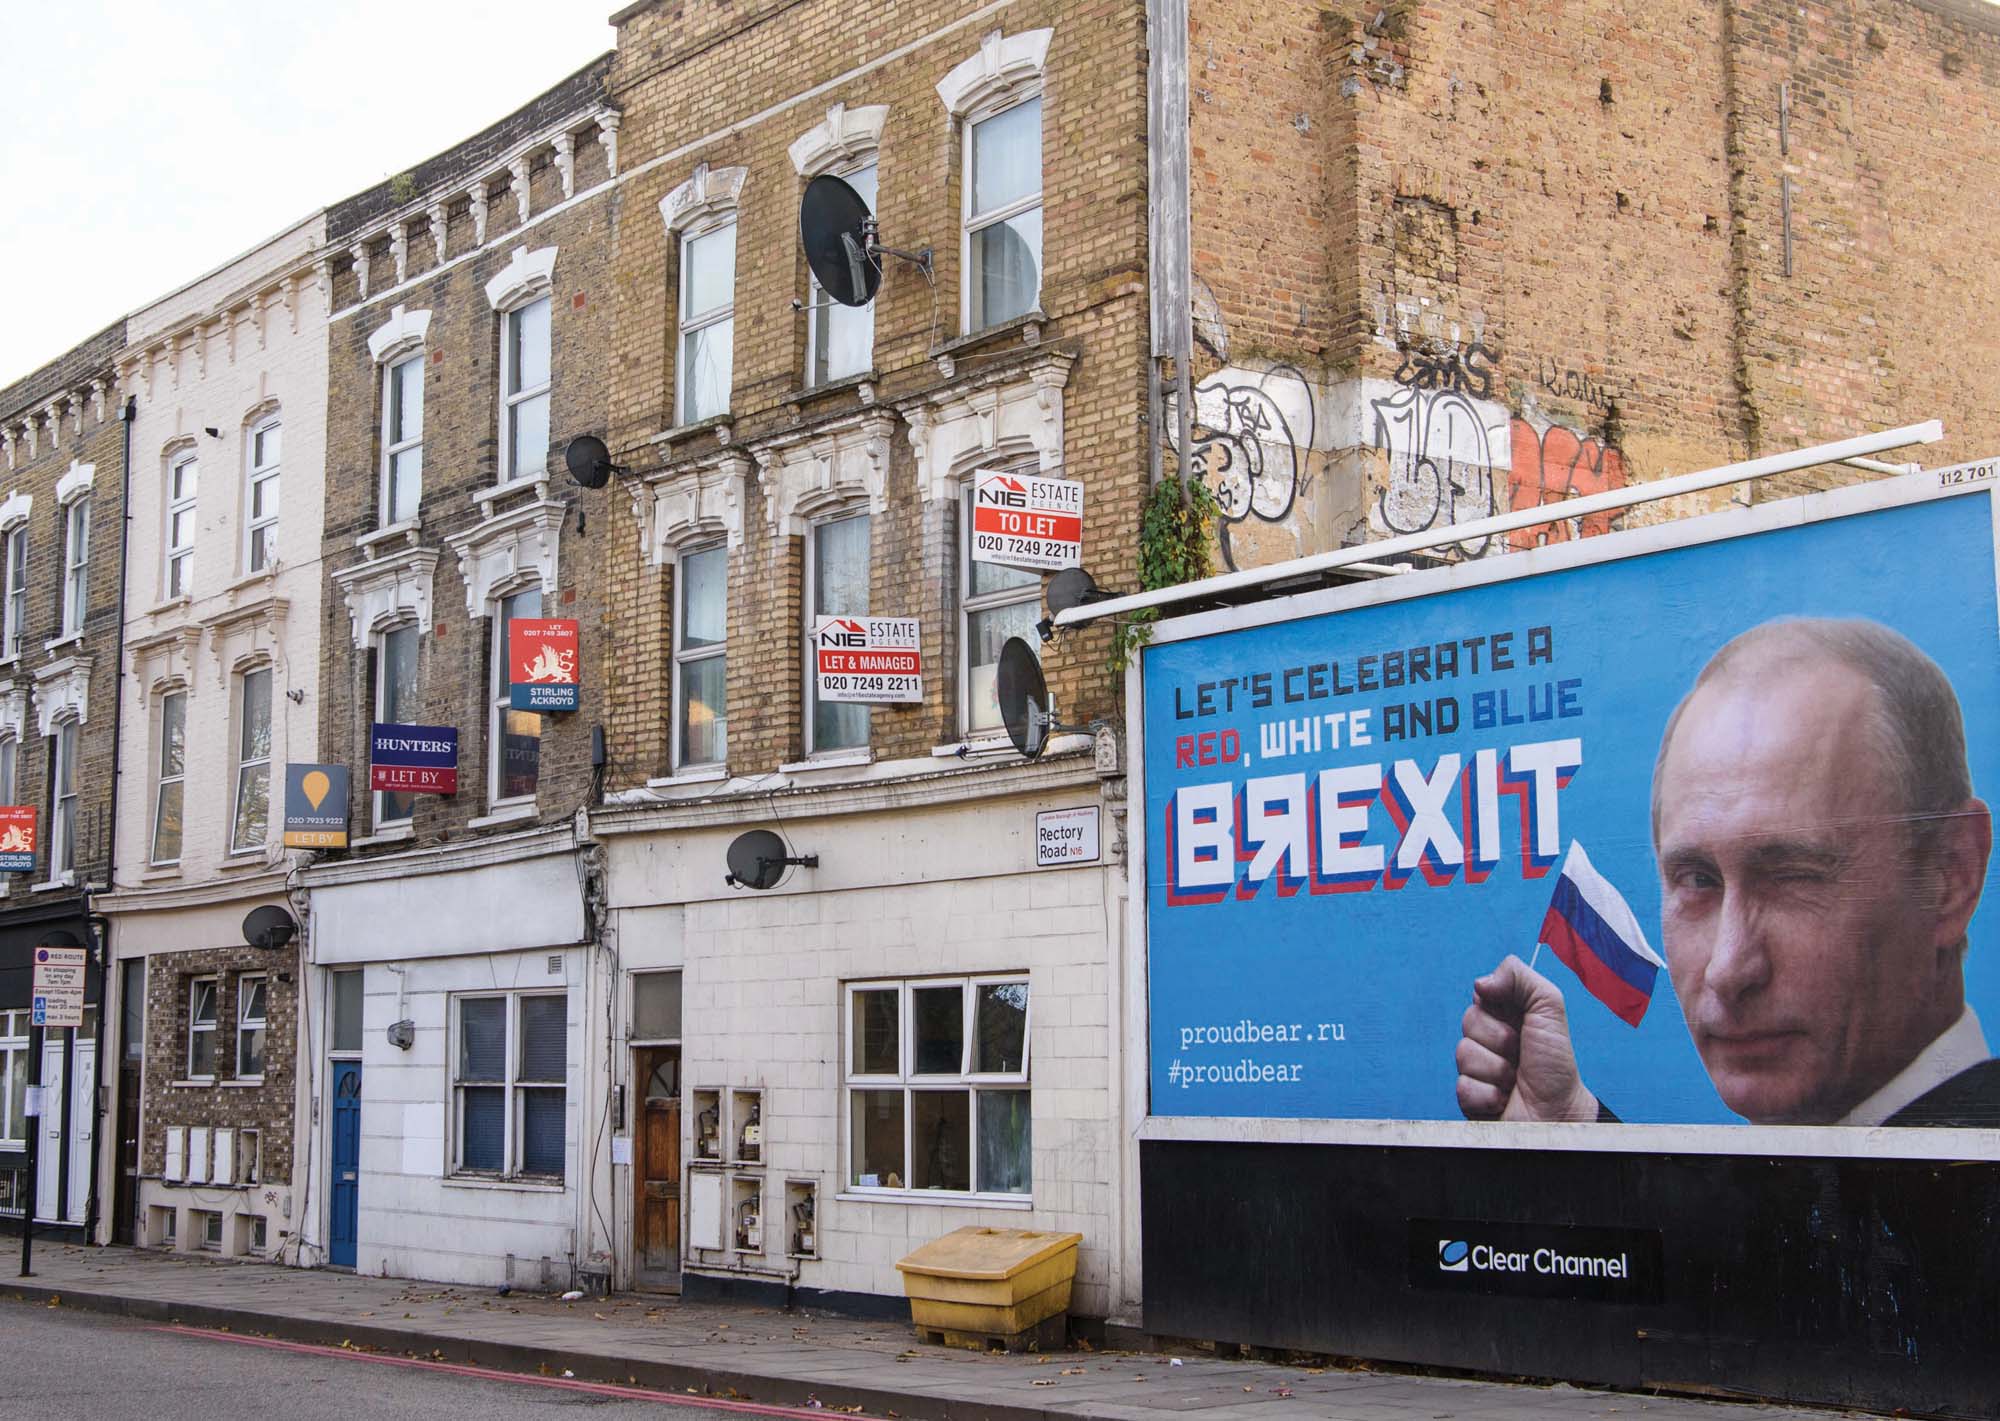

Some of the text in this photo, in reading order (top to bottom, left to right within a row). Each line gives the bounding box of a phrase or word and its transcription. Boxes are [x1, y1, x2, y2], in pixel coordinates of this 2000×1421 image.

[1968, 465, 1993, 480] 701
[979, 482, 1079, 508] N16 ESTATE
[1031, 500, 1078, 511] AGENCY
[999, 512, 1057, 536] TO LET
[978, 535, 1076, 559] 020 7249 2211
[821, 622, 915, 647] N16 ESTATE
[824, 655, 915, 670] LET & MANAGED
[1175, 625, 1553, 720] LET'S CELEBRATE A
[824, 676, 918, 691] 020 7249 2211
[530, 687, 574, 697] STIRLING
[530, 696, 574, 705] ACKROYD
[1176, 678, 1583, 769] RED, WHITE AND BLUE
[376, 738, 451, 753] HUNTERS
[391, 770, 440, 784] LET BY
[287, 816, 304, 824] 020
[295, 833, 334, 844] LET BY
[1040, 826, 1083, 841] Rectory
[1040, 843, 1068, 859] Road
[1180, 1020, 1346, 1050] proudbear.ru
[1168, 1059, 1303, 1089] #proudbear
[1471, 1245, 1628, 1278] Clear Channel
